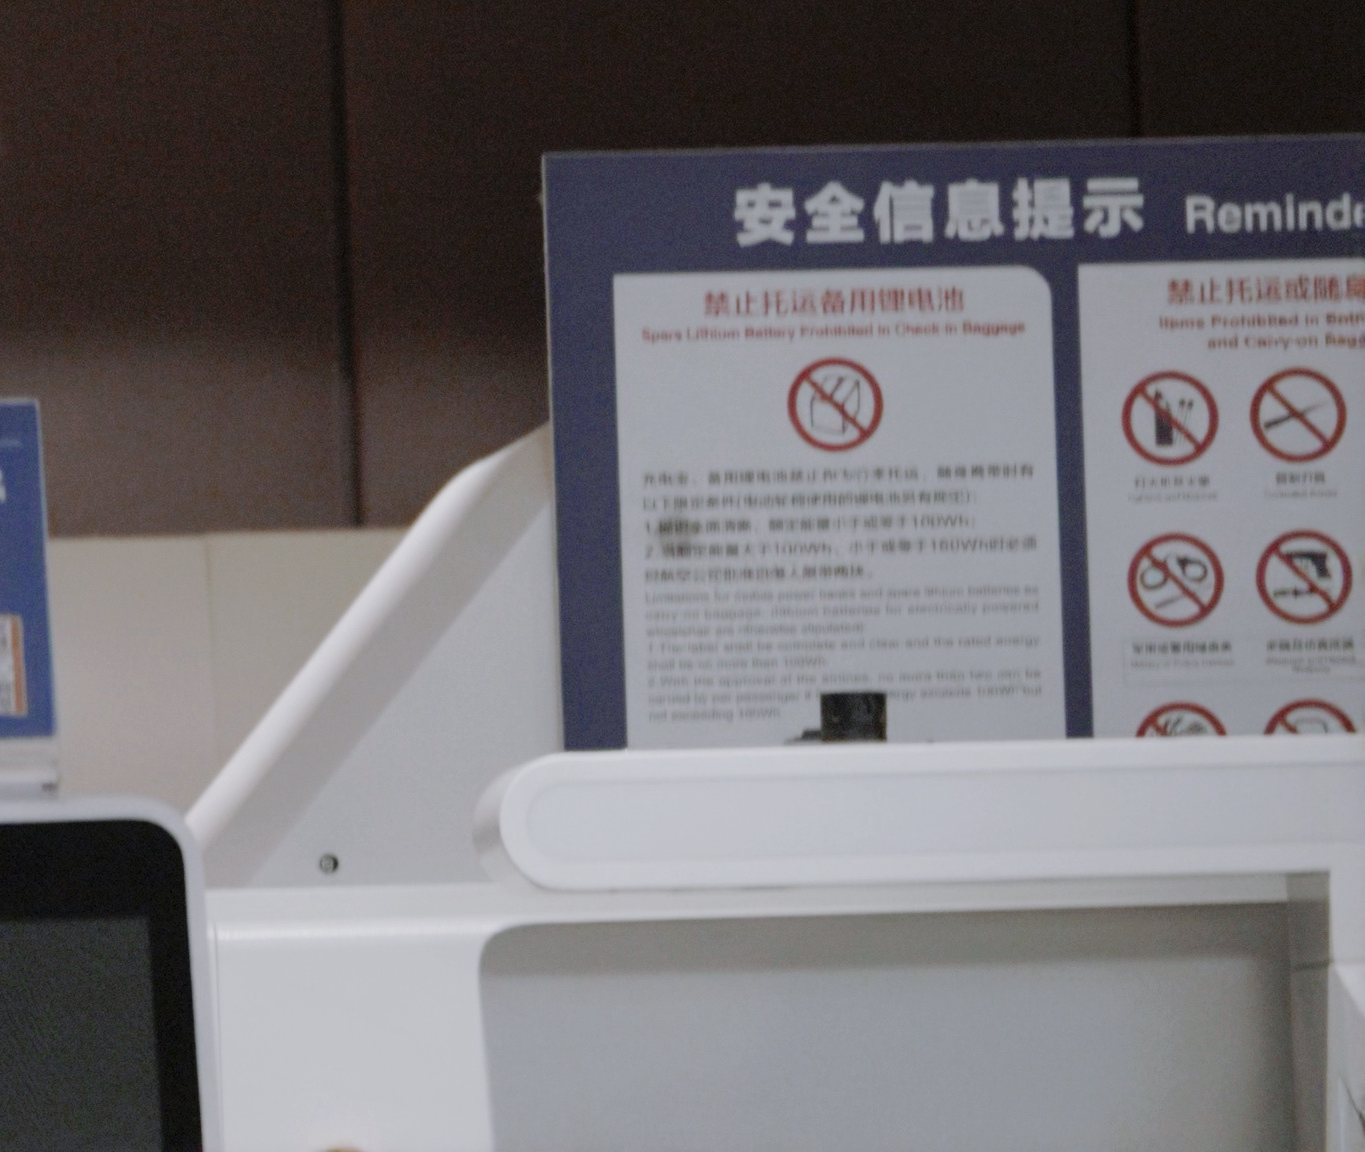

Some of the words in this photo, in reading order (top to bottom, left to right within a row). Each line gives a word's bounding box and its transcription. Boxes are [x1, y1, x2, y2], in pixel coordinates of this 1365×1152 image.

[732, 176, 1144, 248] 安全信息提示
[745, 326, 794, 342] Battery
[963, 321, 1025, 336] Baggage
